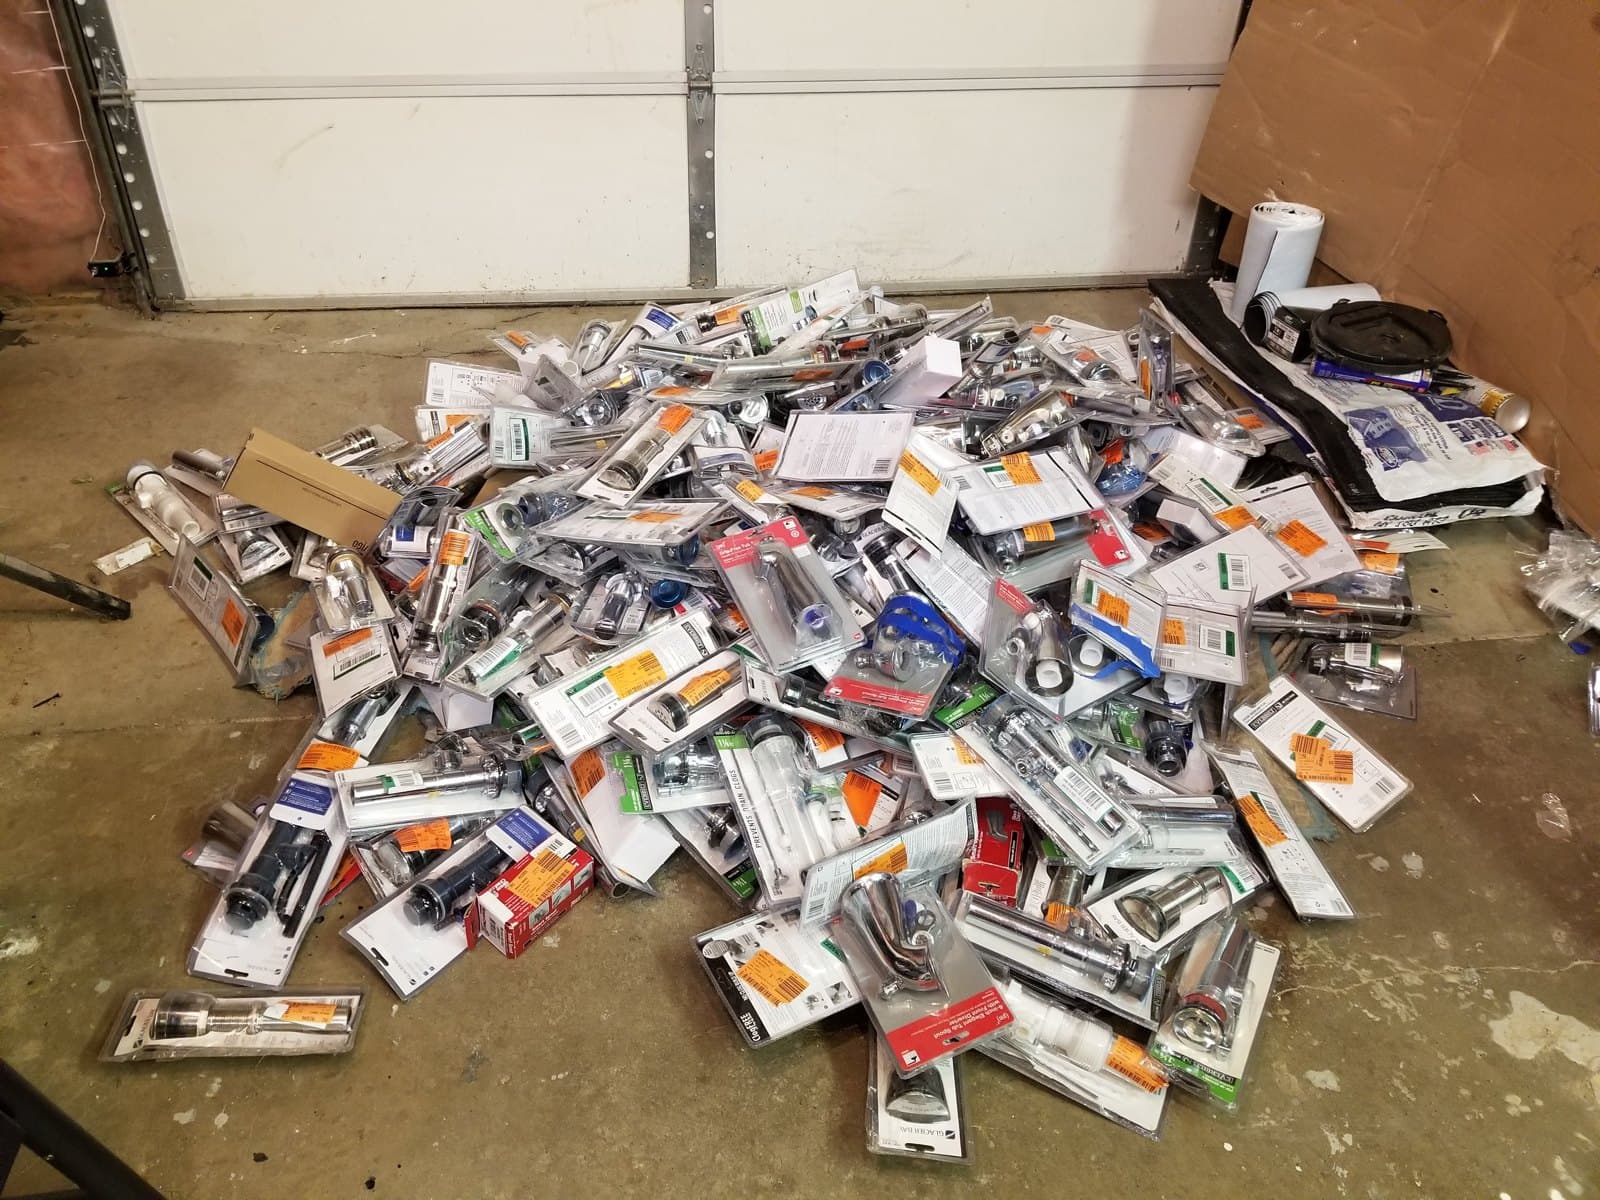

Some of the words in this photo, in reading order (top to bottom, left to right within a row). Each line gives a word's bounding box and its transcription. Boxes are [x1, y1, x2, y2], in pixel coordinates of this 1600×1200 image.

[729, 769, 742, 790] CLOGS
[747, 815, 762, 849] PREVENTS
[740, 1012, 760, 1042] ClogFREE
